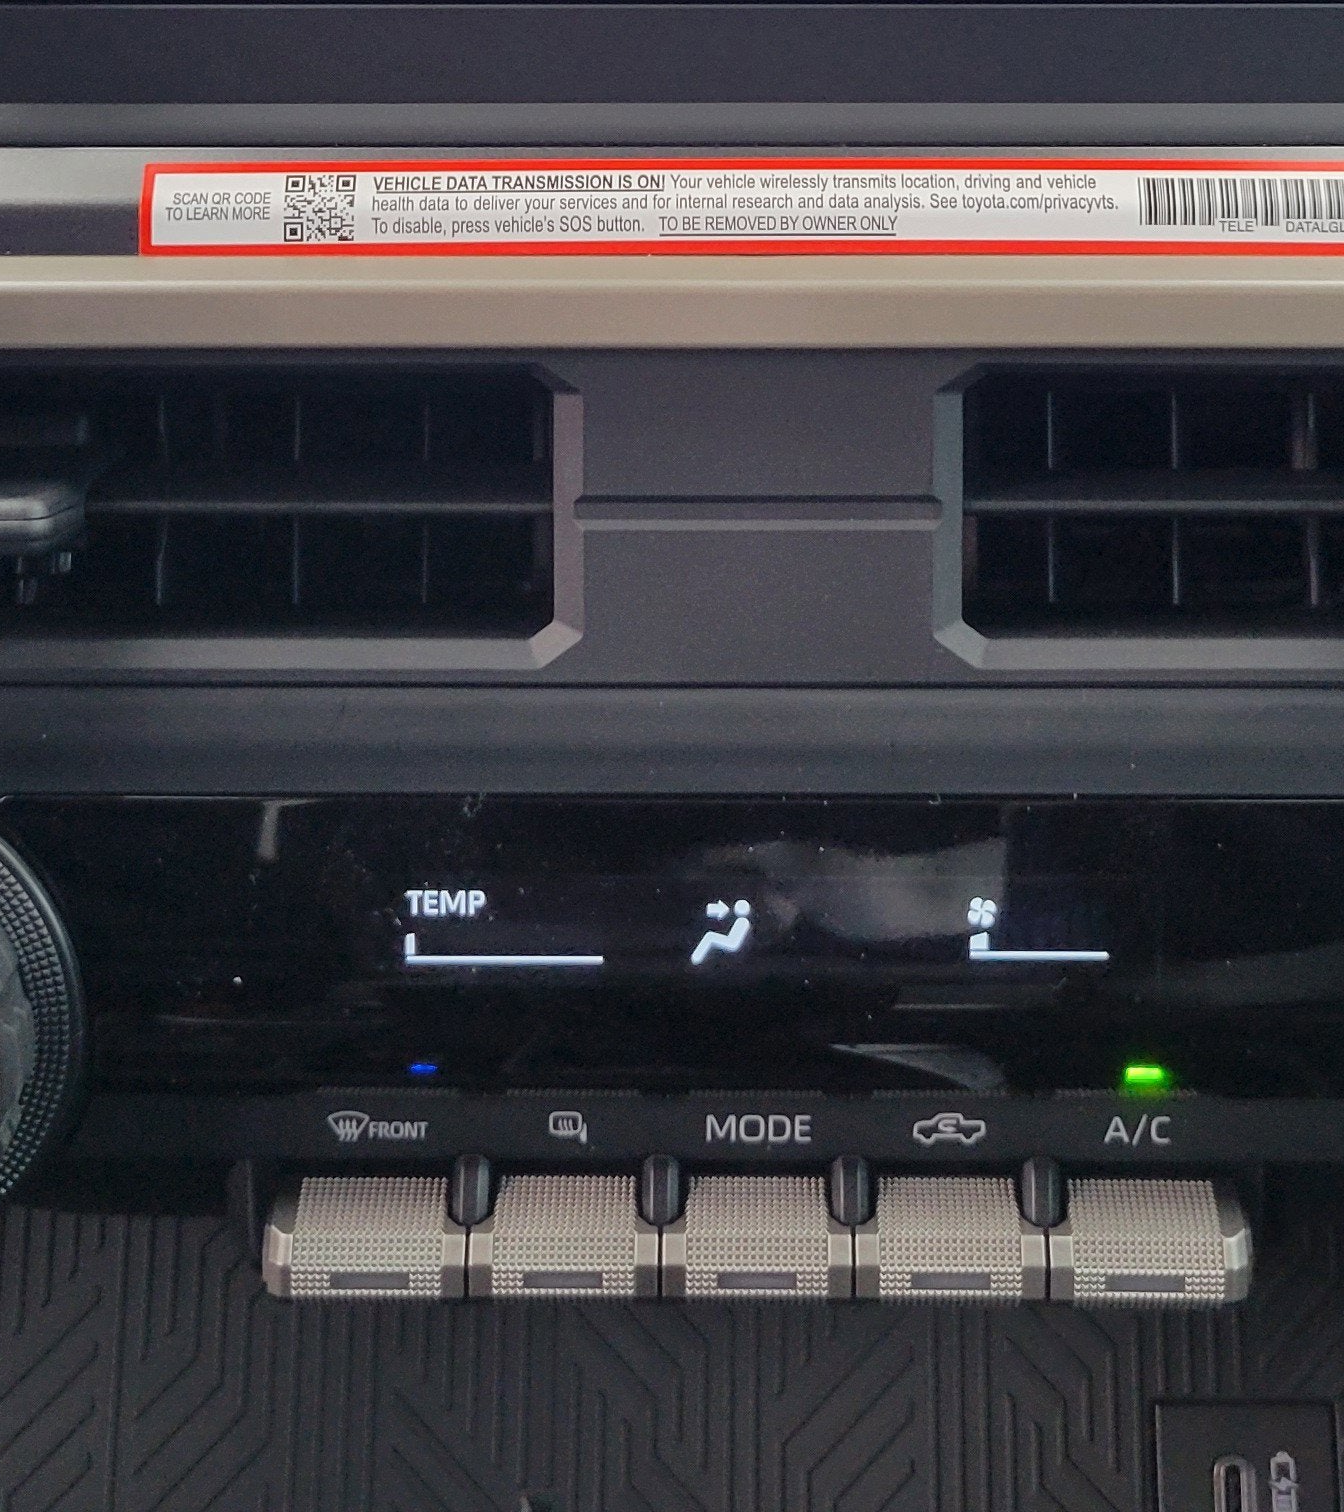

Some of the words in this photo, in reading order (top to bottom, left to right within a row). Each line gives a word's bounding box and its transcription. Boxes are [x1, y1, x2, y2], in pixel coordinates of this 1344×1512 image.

[373, 176, 442, 191] VEHICLE
[446, 176, 488, 190] DATA
[492, 175, 613, 190] TRANSMISSION
[618, 174, 633, 189] IS
[637, 174, 665, 189] ON!
[670, 174, 703, 189] Your
[706, 174, 756, 189] vehicle
[760, 173, 829, 192] wirelessly
[832, 173, 897, 189] transmits
[901, 173, 960, 191] location,
[964, 173, 1011, 192] driving
[1016, 174, 1043, 189] and
[1047, 174, 1097, 189] vehicle
[172, 192, 209, 205] SCAN
[212, 192, 232, 205] QR
[234, 192, 271, 205] CODE
[372, 196, 414, 212] health
[419, 196, 450, 211] data
[455, 196, 468, 211] to
[473, 195, 520, 211] deliver
[524, 197, 556, 214] your
[559, 195, 617, 210] services
[621, 194, 648, 210] and
[653, 194, 671, 209] for
[675, 194, 727, 209] internal
[732, 193, 793, 209] research
[798, 193, 824, 209] and
[828, 193, 859, 209] data
[863, 193, 925, 213] analysis.
[929, 193, 957, 209] See
[962, 193, 1119, 213] toyota.com/privacyvts.
[166, 207, 183, 221] TO
[186, 207, 229, 221] LEARN
[232, 206, 271, 220] MORE
[371, 217, 388, 234] To
[392, 217, 447, 236] disable,
[451, 219, 490, 238] press
[494, 215, 554, 233] vehicle's
[559, 215, 592, 232] SOS
[597, 215, 645, 232] button.
[659, 216, 678, 231] TO
[682, 216, 701, 231] BE
[705, 216, 776, 231] REMOVED
[780, 216, 799, 231] BY
[802, 216, 857, 231] OWNER
[860, 215, 898, 231] ONLY
[1219, 220, 1254, 232] TELE
[404, 888, 487, 918] TEMP
[367, 1120, 429, 1139] FRONT
[704, 1114, 812, 1143] MODE
[1103, 1114, 1172, 1146] A/C
